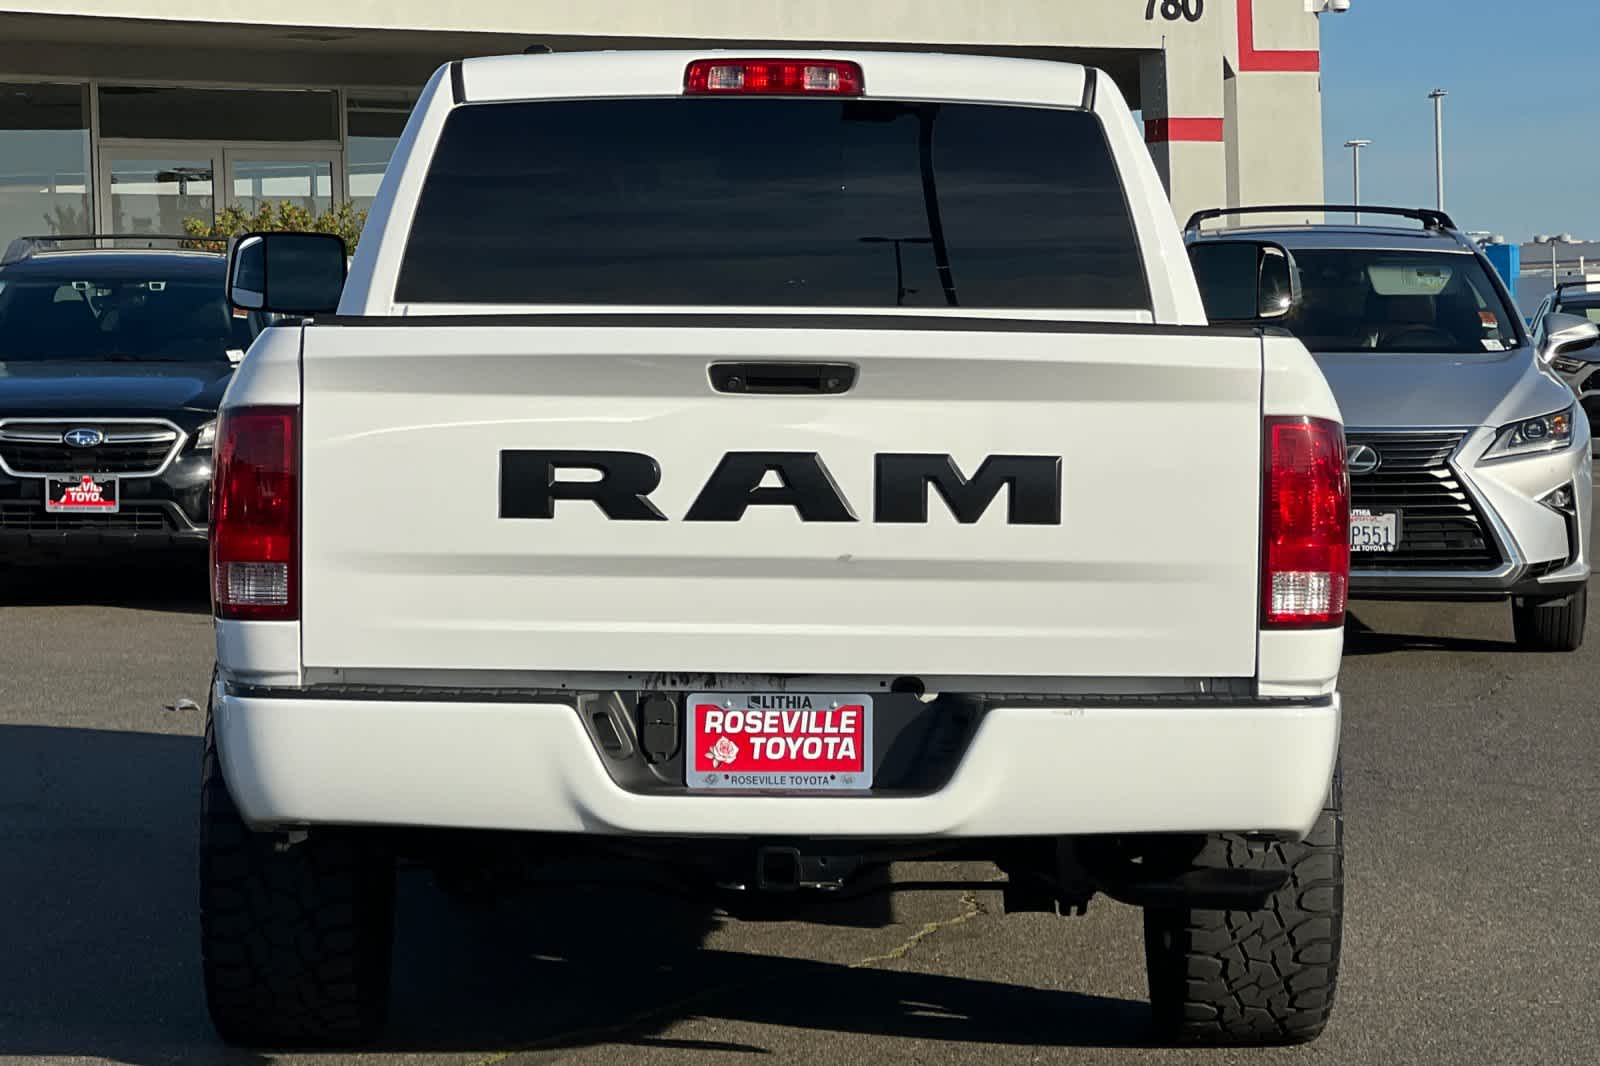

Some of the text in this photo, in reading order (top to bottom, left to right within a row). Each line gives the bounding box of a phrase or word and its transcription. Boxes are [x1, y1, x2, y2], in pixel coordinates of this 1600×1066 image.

[498, 448, 1062, 526] RAM
[1351, 526, 1391, 546] P551
[762, 695, 812, 709] LITHIA
[704, 710, 857, 734] ROSEVILLE
[750, 736, 857, 760] TOYOTA
[731, 775, 829, 785] ROSEVILLE TOYOTA
